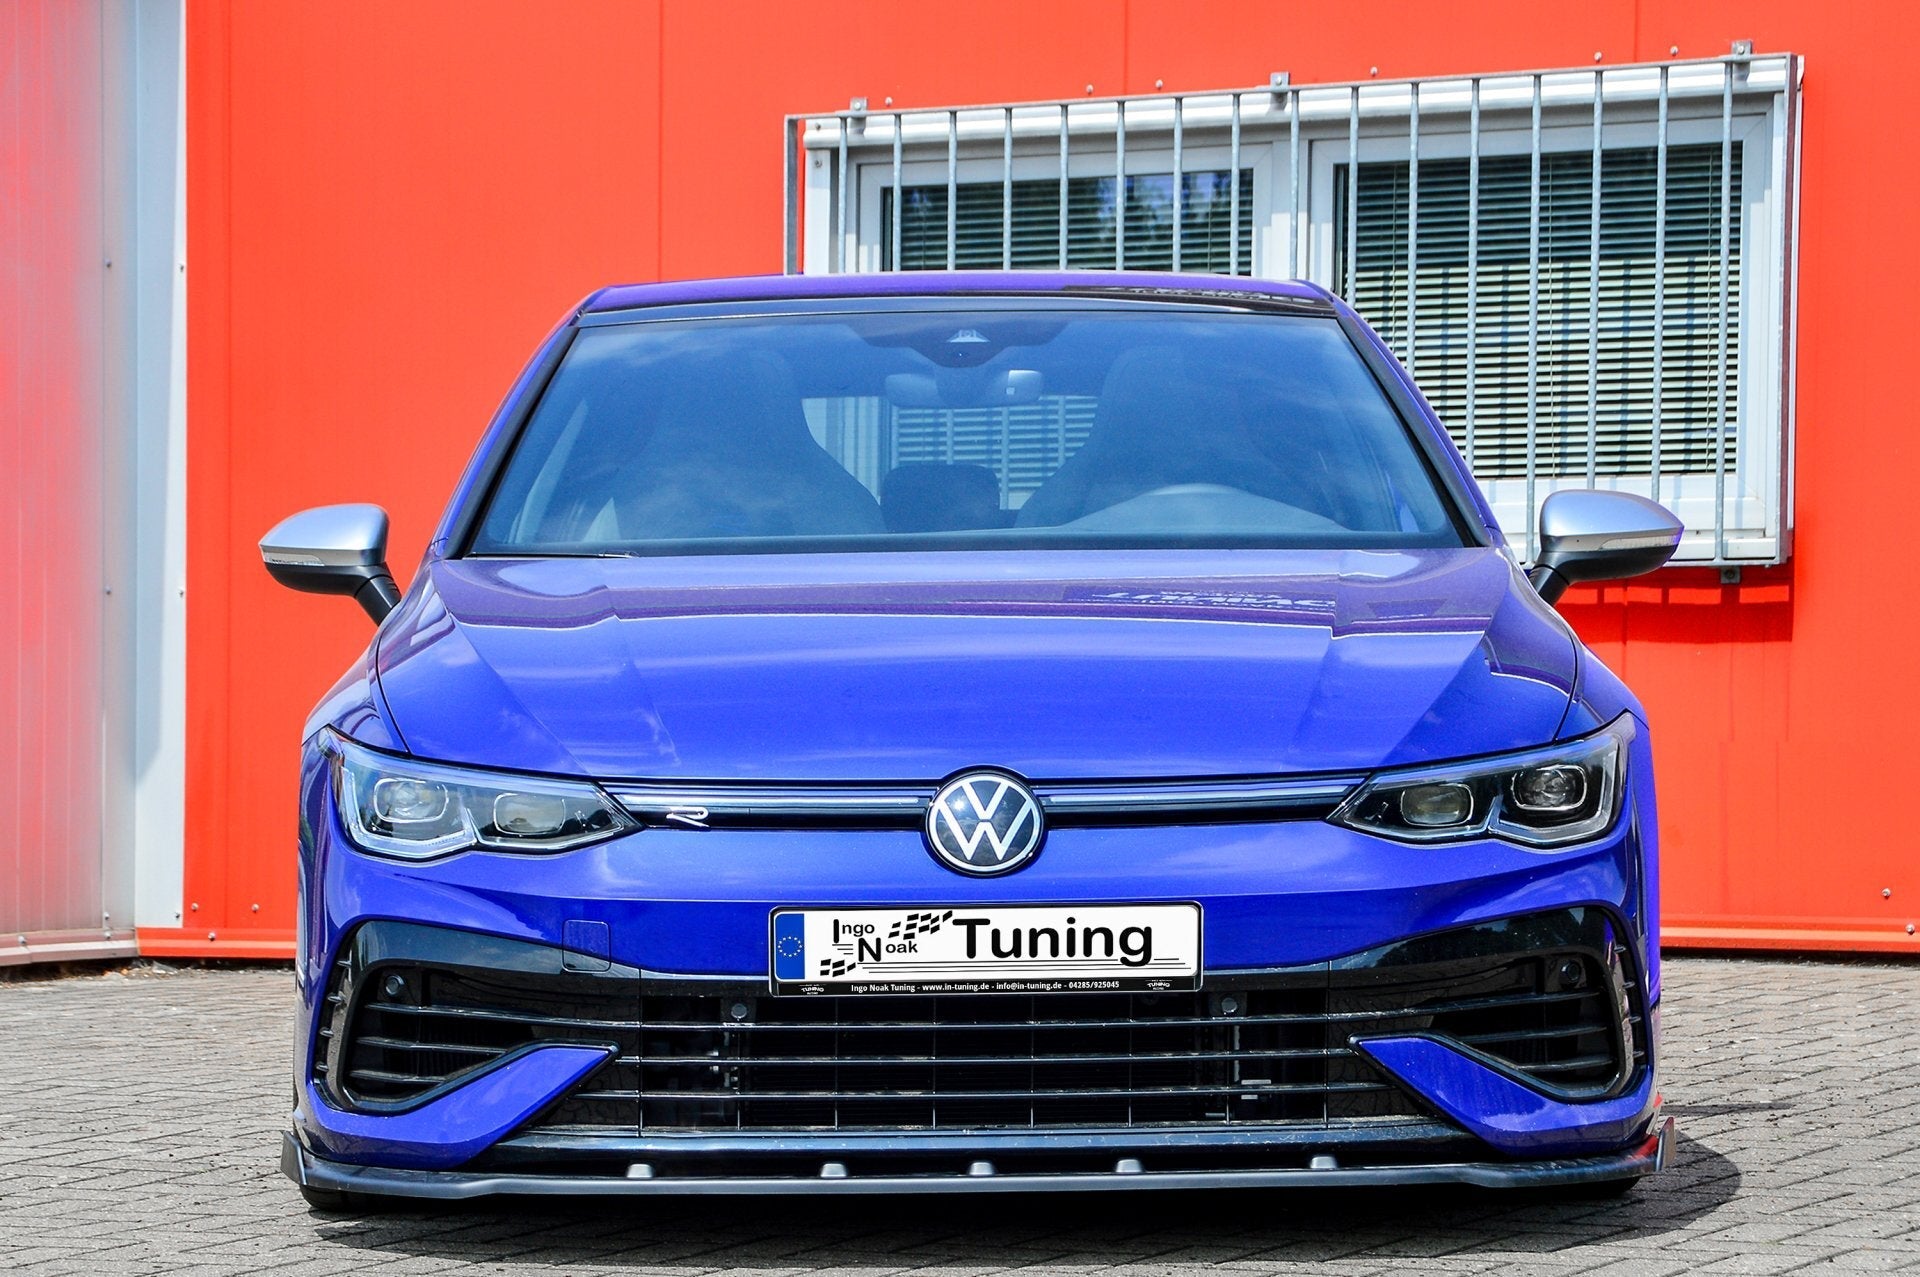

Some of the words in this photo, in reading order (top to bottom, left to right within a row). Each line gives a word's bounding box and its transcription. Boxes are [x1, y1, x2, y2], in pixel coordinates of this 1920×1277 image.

[833, 919, 875, 943] Ingo
[953, 916, 1152, 967] Tuning
[858, 937, 918, 962] Noak
[851, 984, 867, 993] Ingo
[869, 984, 889, 992] Noak
[891, 984, 915, 993] Tuning
[922, 982, 989, 992] www.in-tuning.de
[996, 982, 1062, 991] info@in-tuning.de
[1068, 980, 1120, 989] 04285/925045
